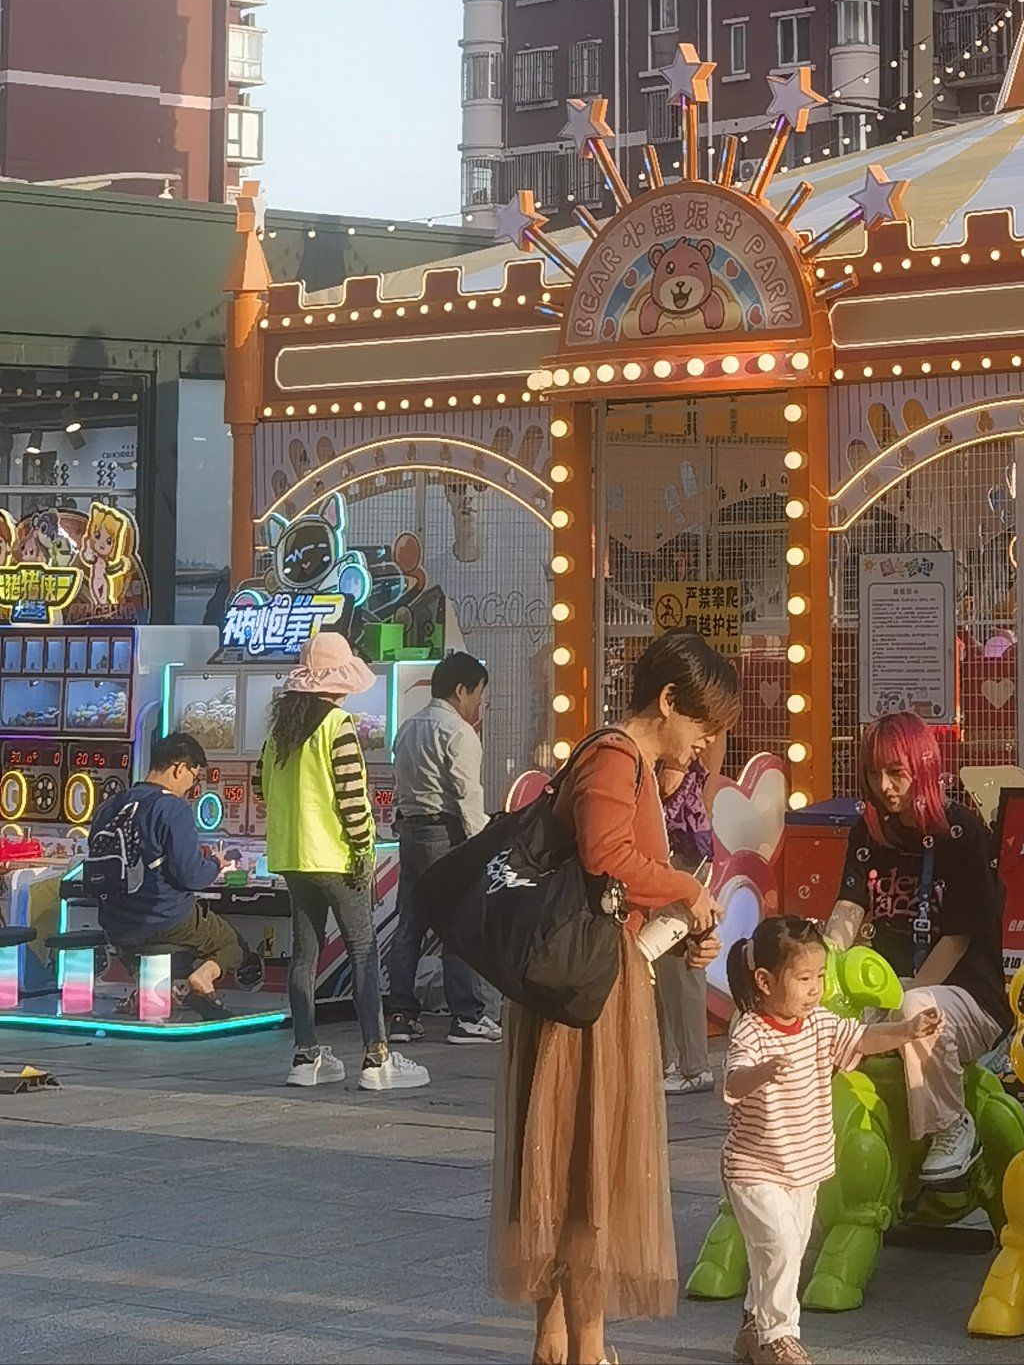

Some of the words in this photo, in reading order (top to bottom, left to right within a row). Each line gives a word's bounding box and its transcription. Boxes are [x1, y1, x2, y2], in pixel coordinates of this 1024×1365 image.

[622, 199, 743, 249] 小熊派对
[574, 246, 622, 336] BEAR
[744, 236, 793, 326] PARK
[685, 586, 739, 609] 严禁攀爬
